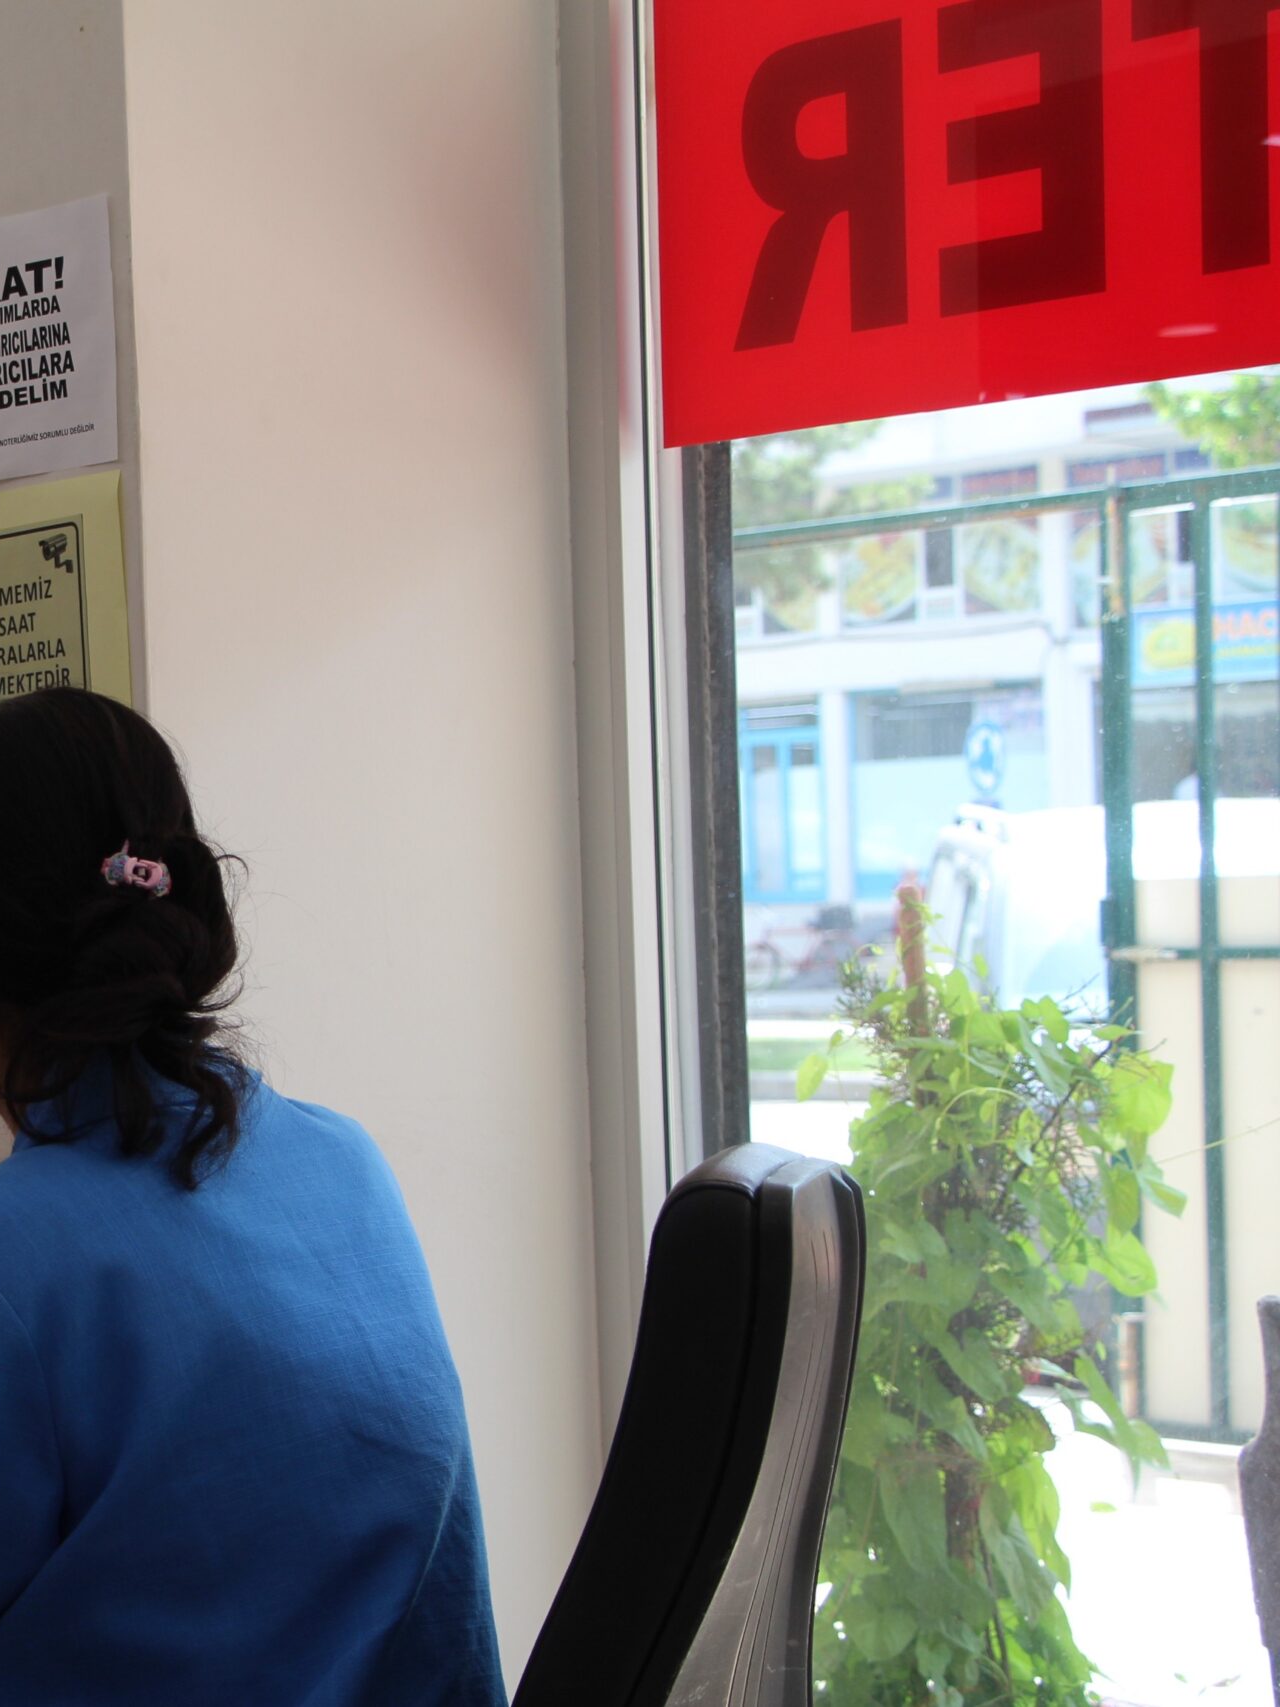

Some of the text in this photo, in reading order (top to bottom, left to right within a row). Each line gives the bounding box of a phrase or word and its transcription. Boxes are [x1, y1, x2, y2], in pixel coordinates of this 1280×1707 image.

[0, 433, 39, 447] NOTERLİĞİMİZ
[39, 428, 69, 441] SORUMLU
[69, 422, 95, 435] DEĞİLDİR
